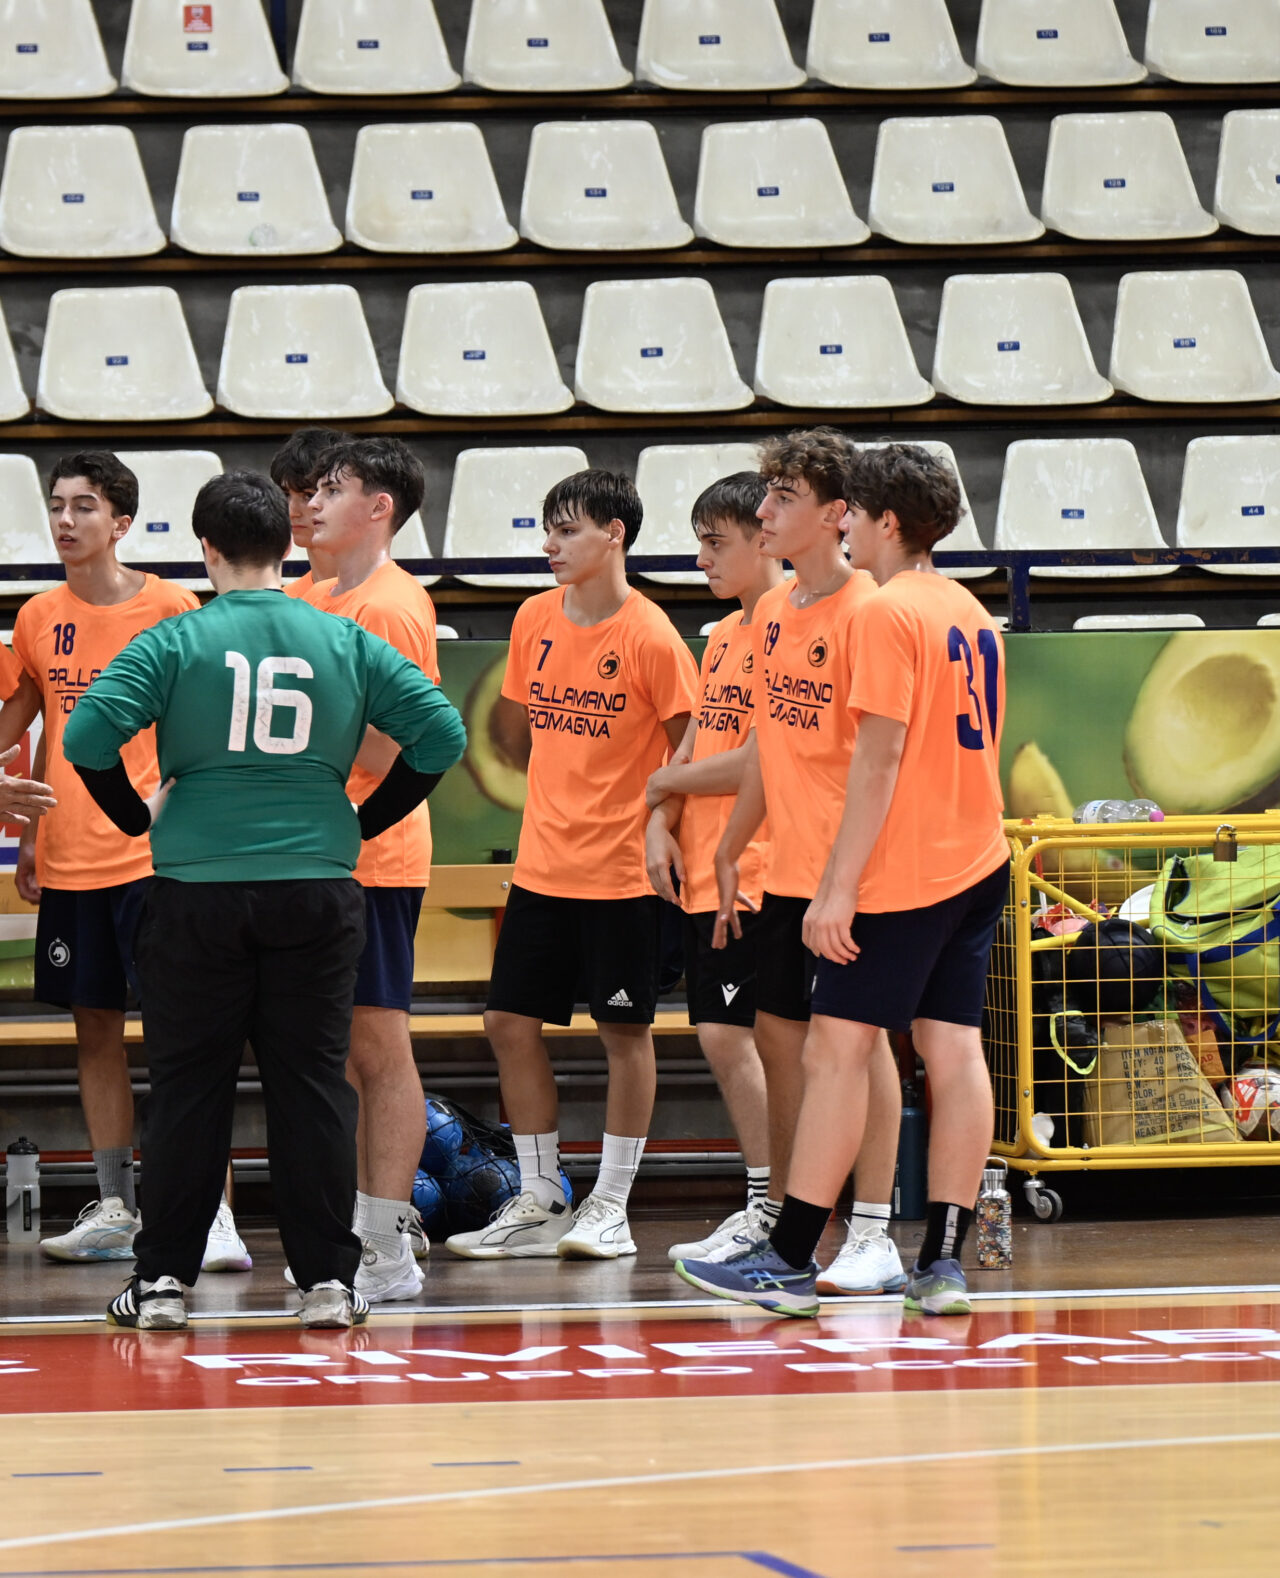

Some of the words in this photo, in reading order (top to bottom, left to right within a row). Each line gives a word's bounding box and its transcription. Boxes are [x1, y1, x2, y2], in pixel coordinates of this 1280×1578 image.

[53, 622, 76, 656] 18
[537, 639, 553, 671] 7
[225, 650, 314, 754] 16
[529, 682, 626, 712] ALLAMANO
[948, 625, 999, 750] 31
[607, 1000, 633, 1008] adidas
[1154, 1056, 1164, 1065] 40
[1062, 1350, 1280, 1365] ICC
